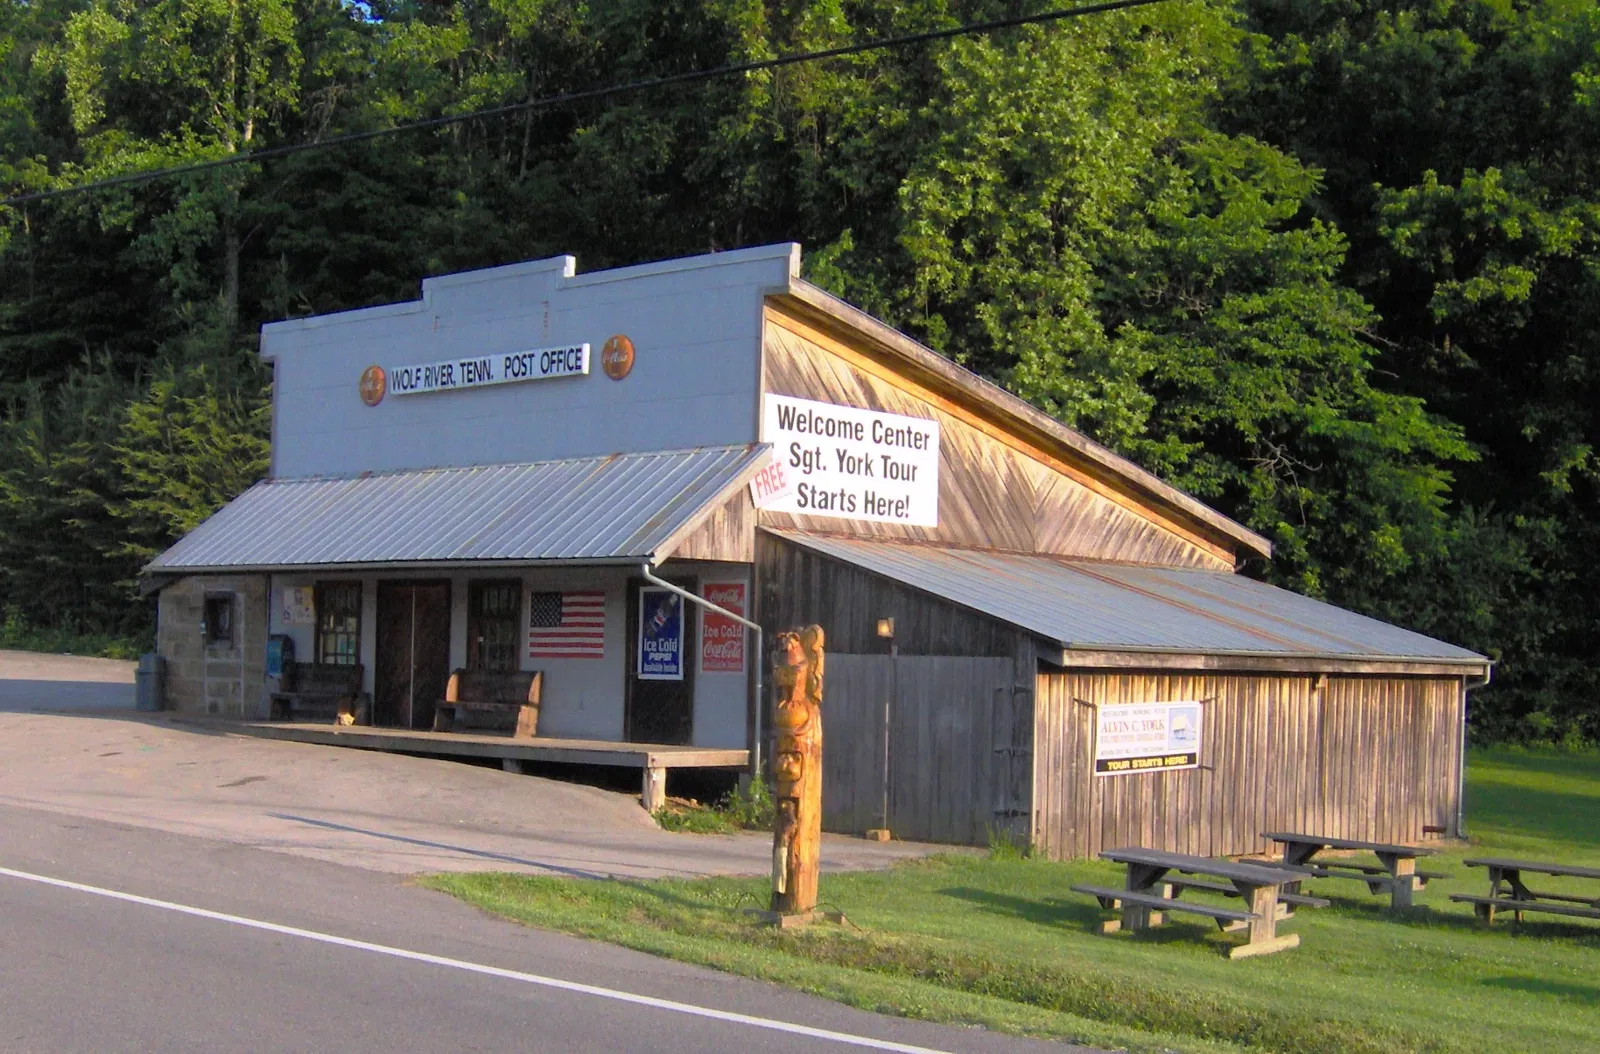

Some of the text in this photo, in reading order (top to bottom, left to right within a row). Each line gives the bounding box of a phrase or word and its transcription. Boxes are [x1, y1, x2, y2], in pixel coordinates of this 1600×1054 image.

[391, 368, 421, 391] WOLF
[424, 364, 456, 387] RIVER,
[460, 359, 494, 383] TENN.
[505, 353, 535, 378] POST
[540, 348, 582, 374] OFFICE
[777, 404, 930, 450] Welcome Center
[790, 442, 918, 482] Sgt. York Tour
[753, 462, 786, 499] FREE
[797, 482, 910, 518] Starts Here!
[704, 625, 742, 638] Ice Cold
[644, 638, 677, 652] Ice Cold
[649, 652, 673, 661] PEPSI
[1100, 720, 1129, 733] ALVIN
[1141, 719, 1166, 731] YORK
[1107, 760, 1130, 770] TOUR
[1132, 757, 1163, 768] STARTS
